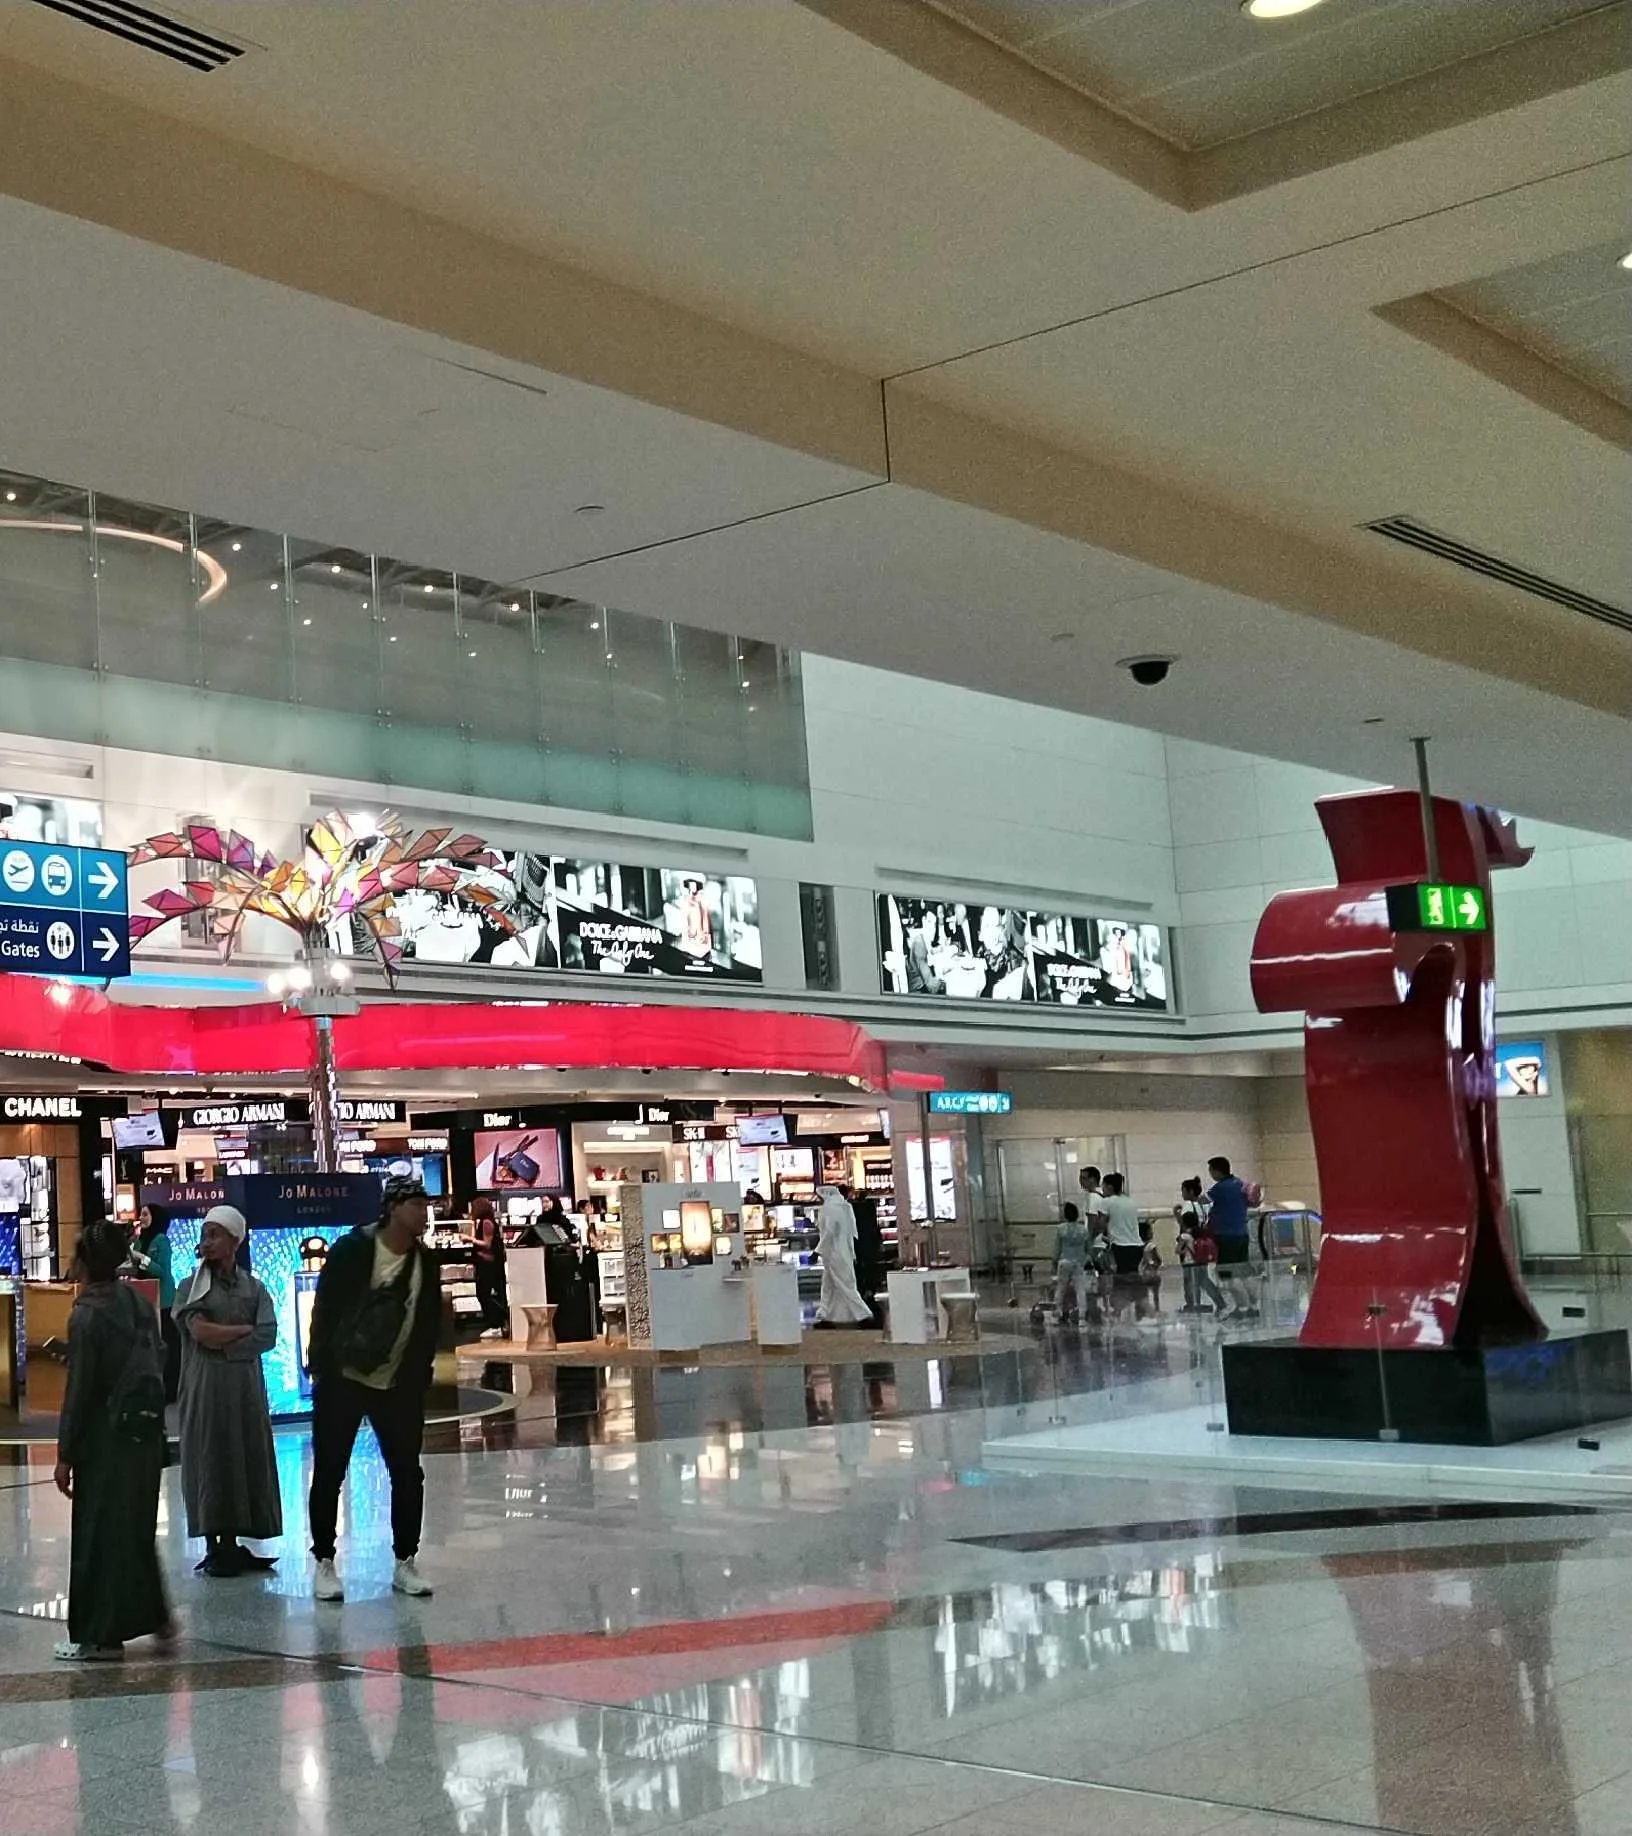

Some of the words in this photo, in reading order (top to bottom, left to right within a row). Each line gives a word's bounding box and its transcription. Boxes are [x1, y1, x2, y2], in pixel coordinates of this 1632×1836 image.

[1, 940, 40, 958] Gates
[4, 1097, 82, 1118] CHANEL
[193, 1107, 239, 1125] GIORGIO
[241, 1102, 285, 1121] ARMANI
